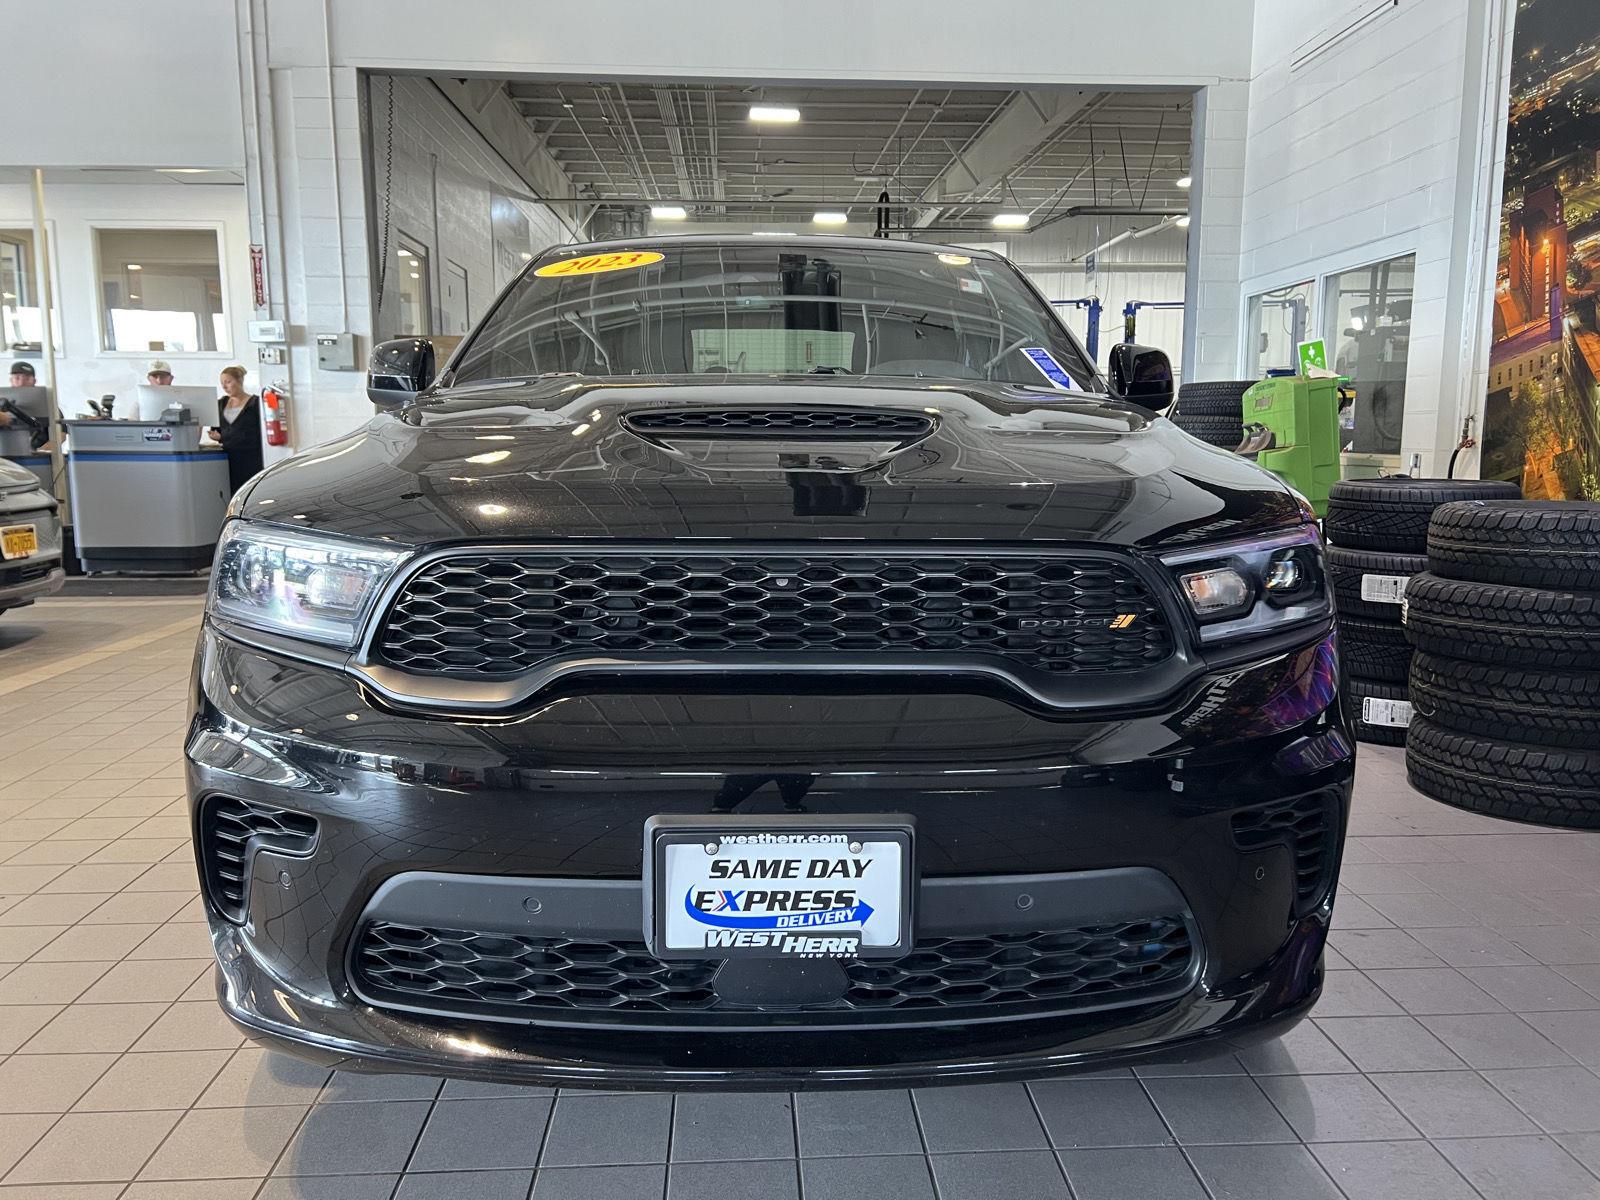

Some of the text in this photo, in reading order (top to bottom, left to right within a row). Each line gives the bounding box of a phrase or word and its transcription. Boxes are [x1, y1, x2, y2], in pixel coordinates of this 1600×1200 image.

[555, 254, 642, 273] 2023
[1019, 618, 1114, 629] DODGE
[720, 834, 848, 845] westherr.com
[709, 859, 873, 879] SAME DAY
[695, 890, 856, 912] EXPRESS
[776, 909, 857, 928] DELIVERY
[706, 929, 859, 953] WEST HERR
